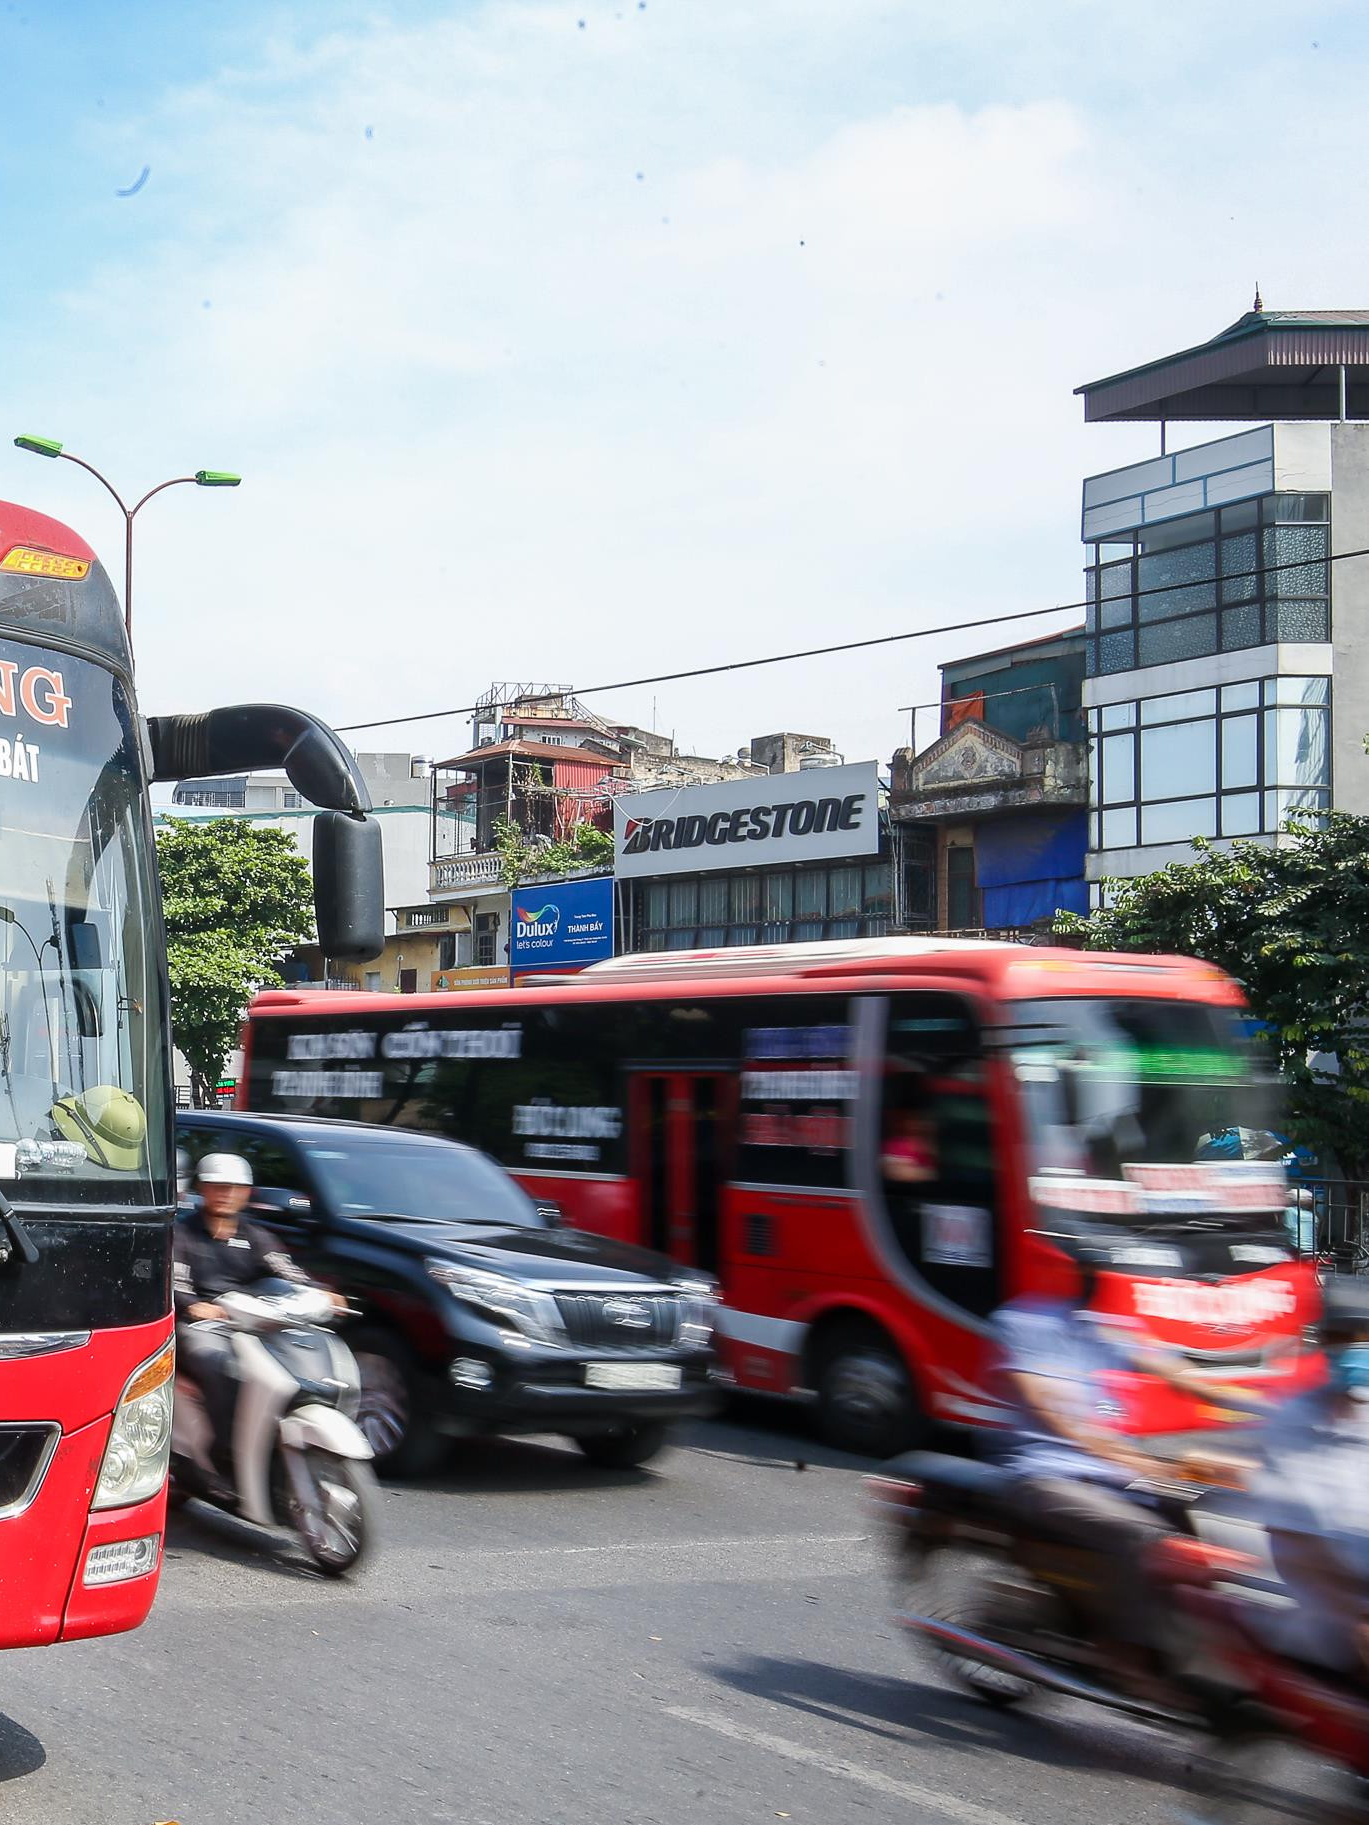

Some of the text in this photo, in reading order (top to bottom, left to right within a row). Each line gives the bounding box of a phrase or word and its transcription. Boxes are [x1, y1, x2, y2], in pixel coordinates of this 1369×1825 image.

[622, 794, 866, 854] BRIDGESTONE
[517, 921, 553, 938] Dulux
[517, 940, 530, 949] let's
[531, 939, 553, 948] colour
